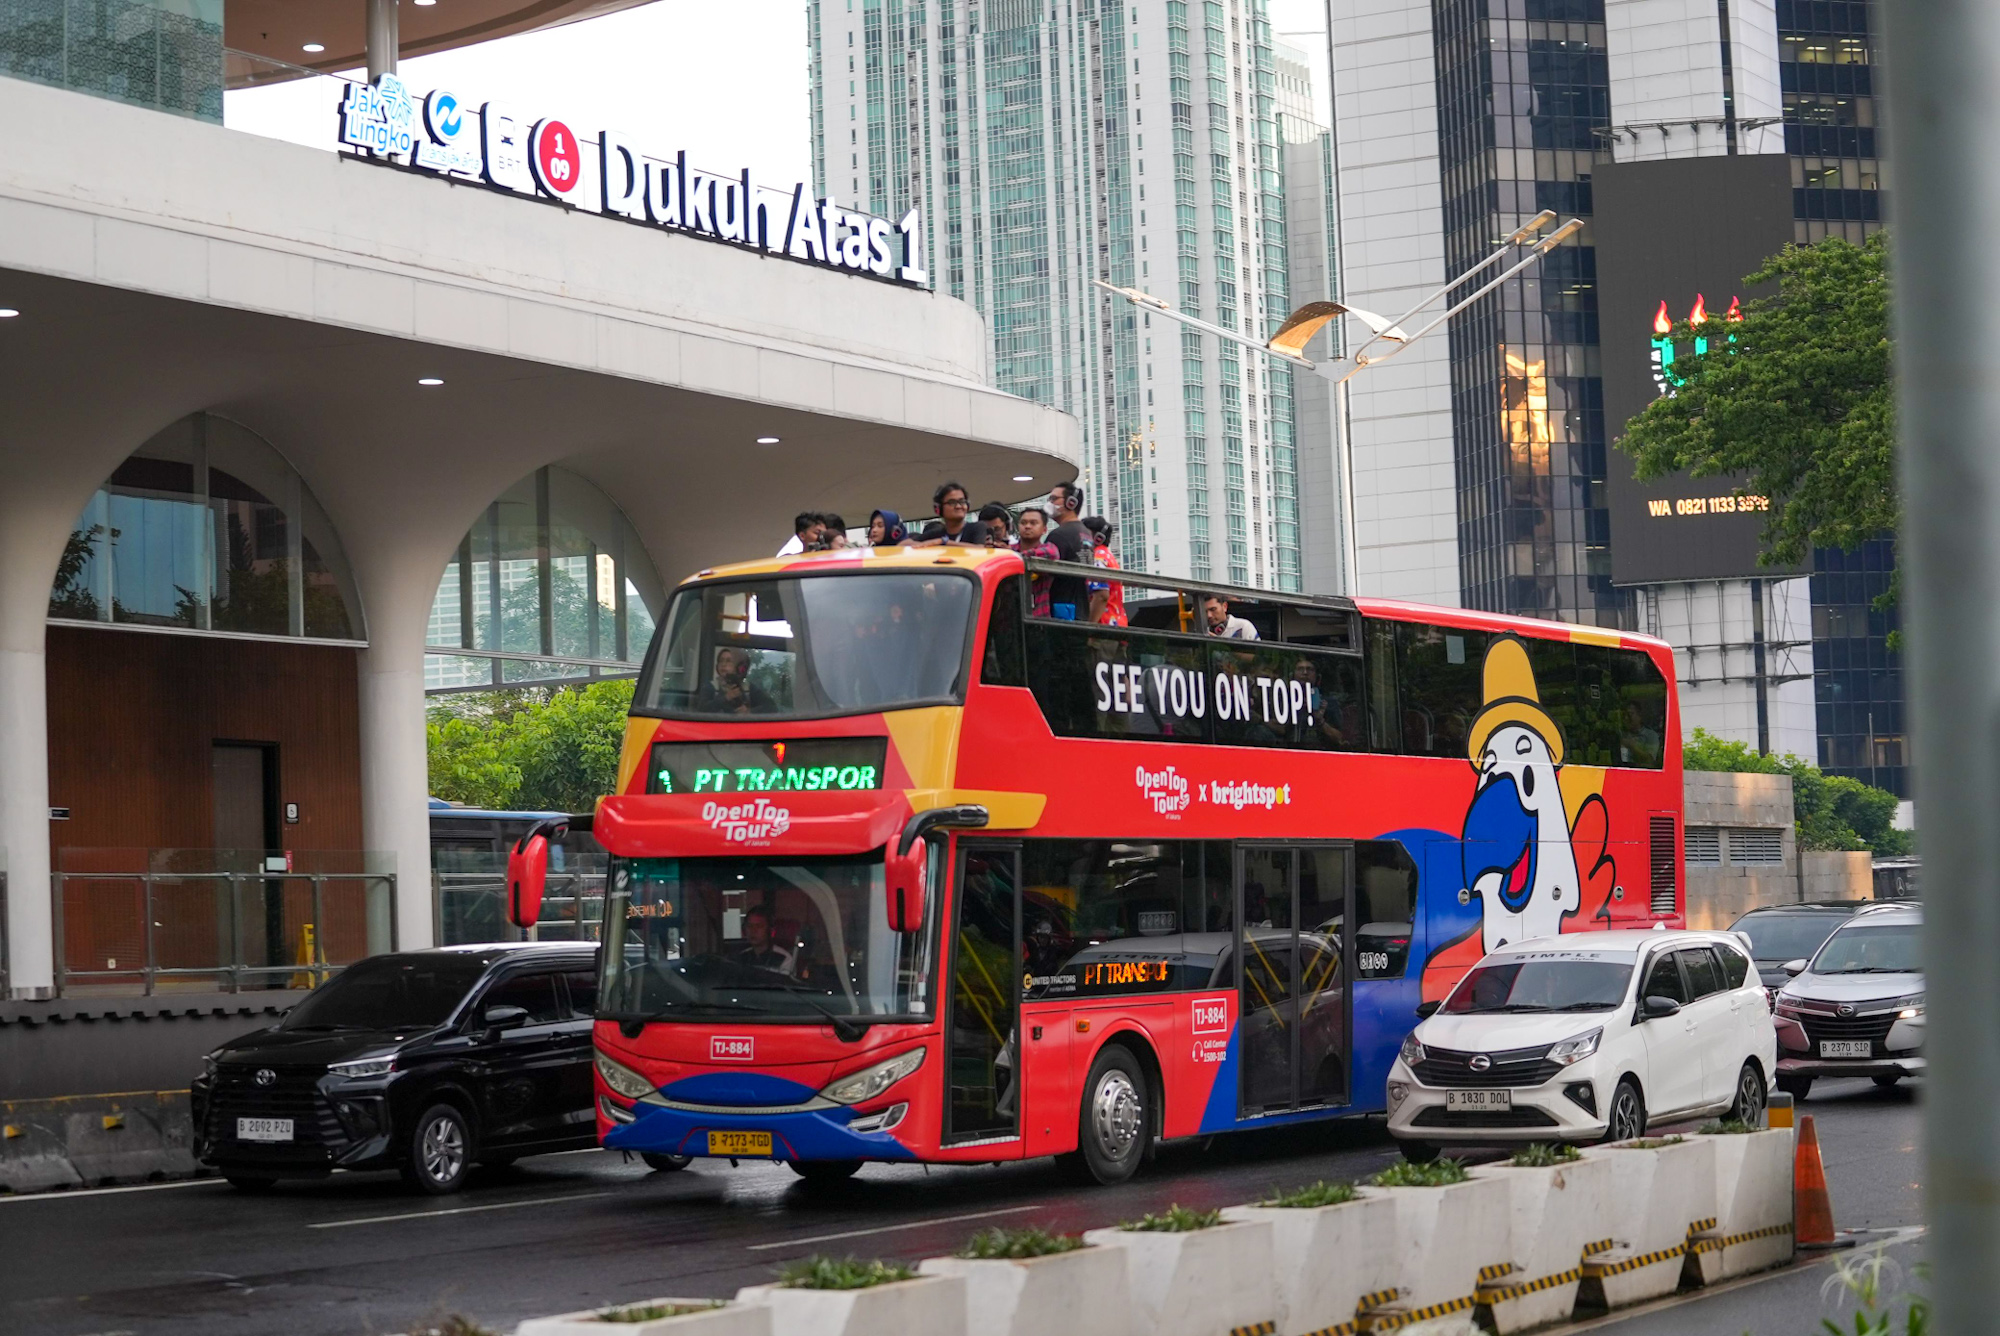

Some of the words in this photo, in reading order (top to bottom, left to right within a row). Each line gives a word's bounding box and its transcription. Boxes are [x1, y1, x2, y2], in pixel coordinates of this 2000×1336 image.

[349, 86, 380, 117] Jak
[349, 115, 410, 152] Lingko
[553, 132, 566, 155] 1
[549, 156, 571, 182] 09
[600, 131, 783, 250] Dukuh
[789, 183, 894, 275] Atas
[897, 208, 927, 284] 1
[1647, 499, 1672, 517] WA
[1676, 497, 1707, 516] 0821
[1708, 496, 1737, 514] 1133
[1095, 661, 1144, 713] SEE
[1152, 667, 1206, 718] YOU
[1215, 672, 1250, 722] ON
[1256, 677, 1314, 727] TOP!
[693, 768, 730, 793] PT
[734, 765, 877, 792] TRANSPOR
[1210, 780, 1291, 811] brightspot
[1514, 952, 1602, 961] SIMPLE
[1050, 974, 1076, 985] TRACTORS
[1084, 964, 1104, 985] PT
[1195, 1006, 1225, 1025] TJ-884
[714, 1041, 751, 1055] TJ-884
[1821, 1042, 1827, 1052] B
[1830, 1042, 1851, 1052] 2370
[1854, 1042, 1869, 1052] SIR
[1448, 1092, 1455, 1104] B
[1461, 1092, 1485, 1104] 1830
[1490, 1092, 1508, 1104] DOL
[240, 1120, 245, 1131] B
[710, 1133, 716, 1146] B
[722, 1133, 747, 1147] 7173
